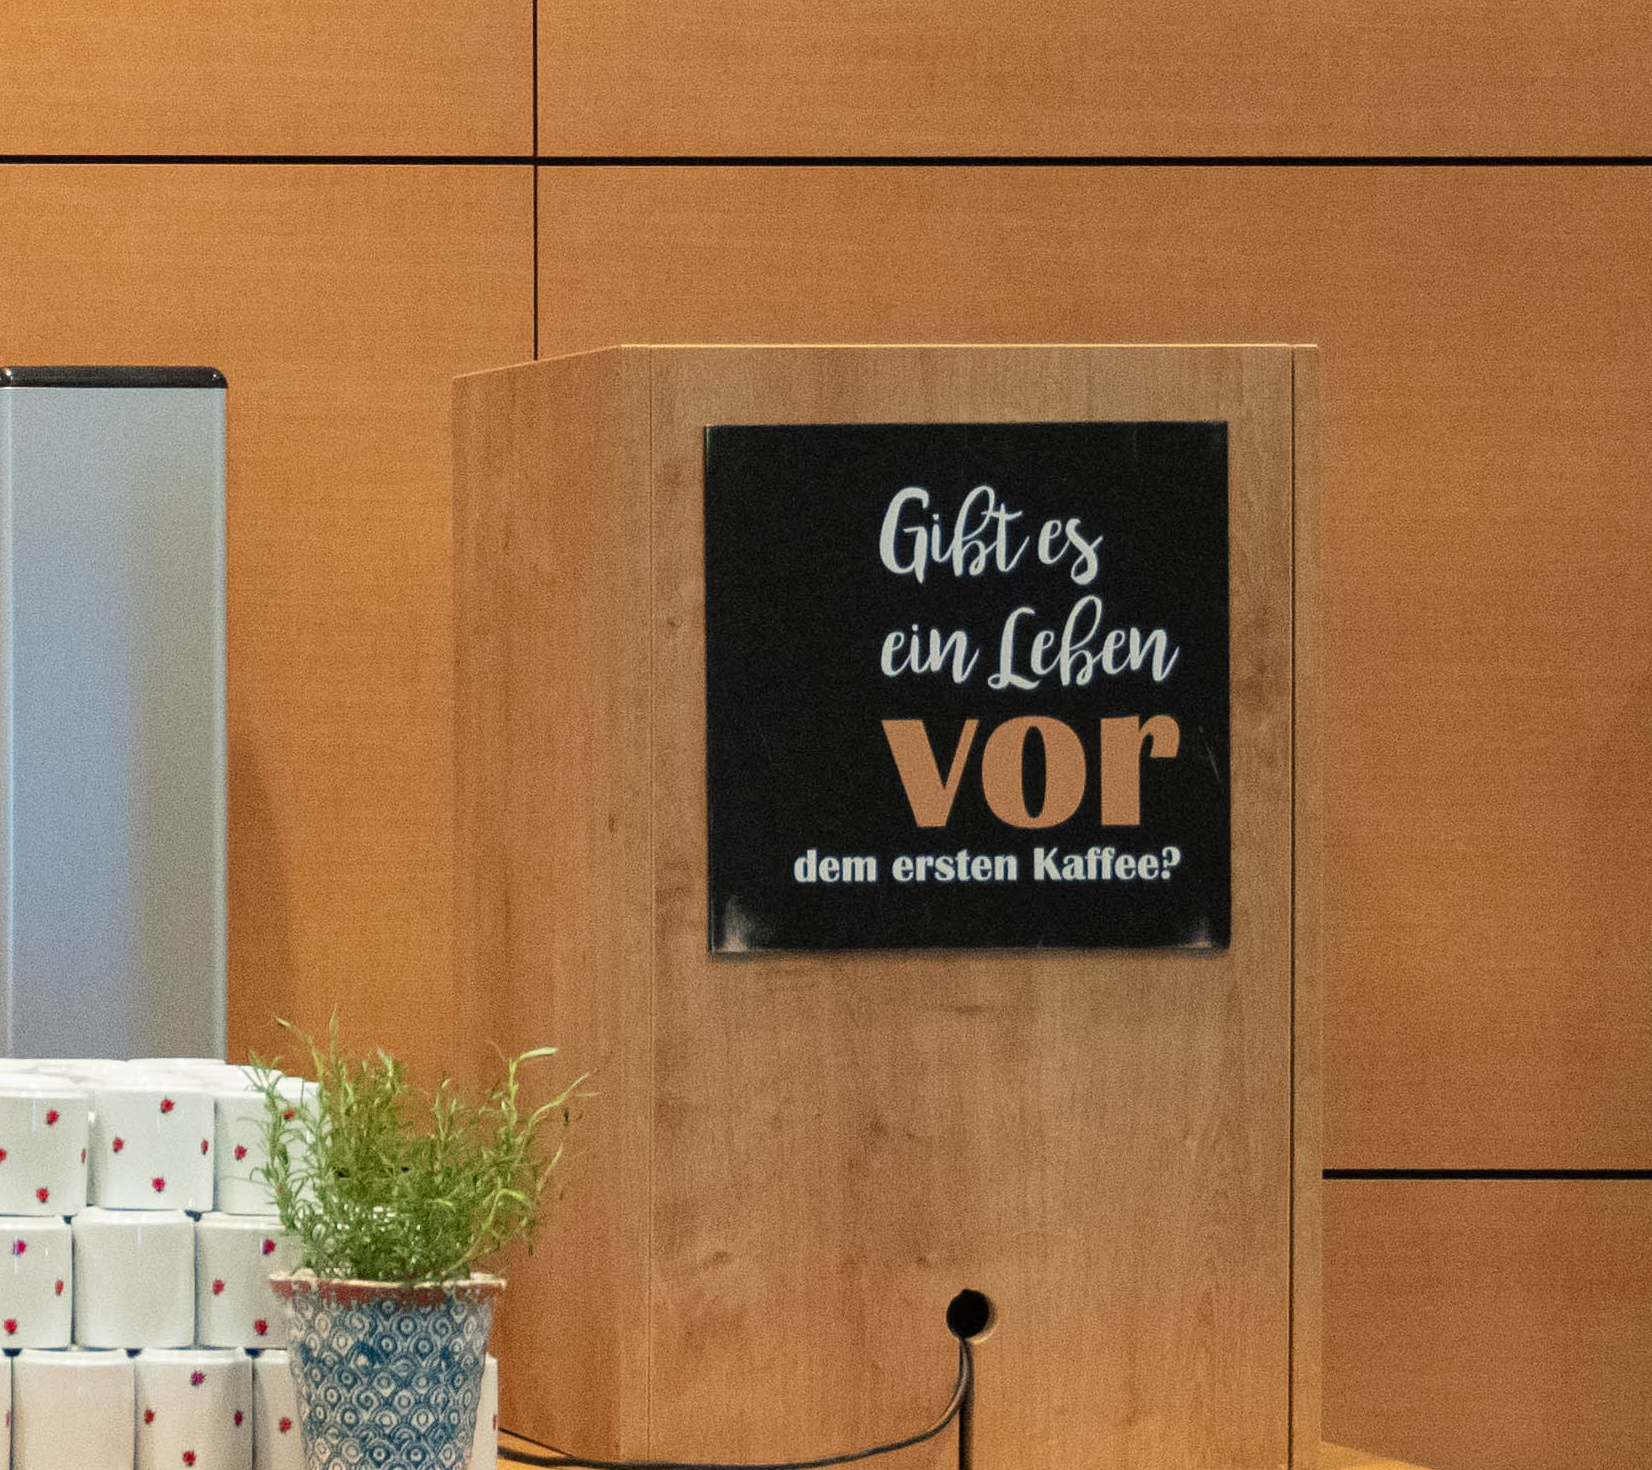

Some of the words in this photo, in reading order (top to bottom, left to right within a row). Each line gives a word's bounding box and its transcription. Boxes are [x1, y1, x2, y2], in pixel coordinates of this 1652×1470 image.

[879, 485, 1030, 584] Gibt
[1037, 516, 1103, 586] es
[880, 623, 979, 684] ein
[987, 595, 1180, 690] Leben
[881, 714, 1181, 830] vor
[793, 849, 877, 883] dem
[892, 848, 1018, 882] ersten
[1034, 845, 1182, 881] Kaffee?
